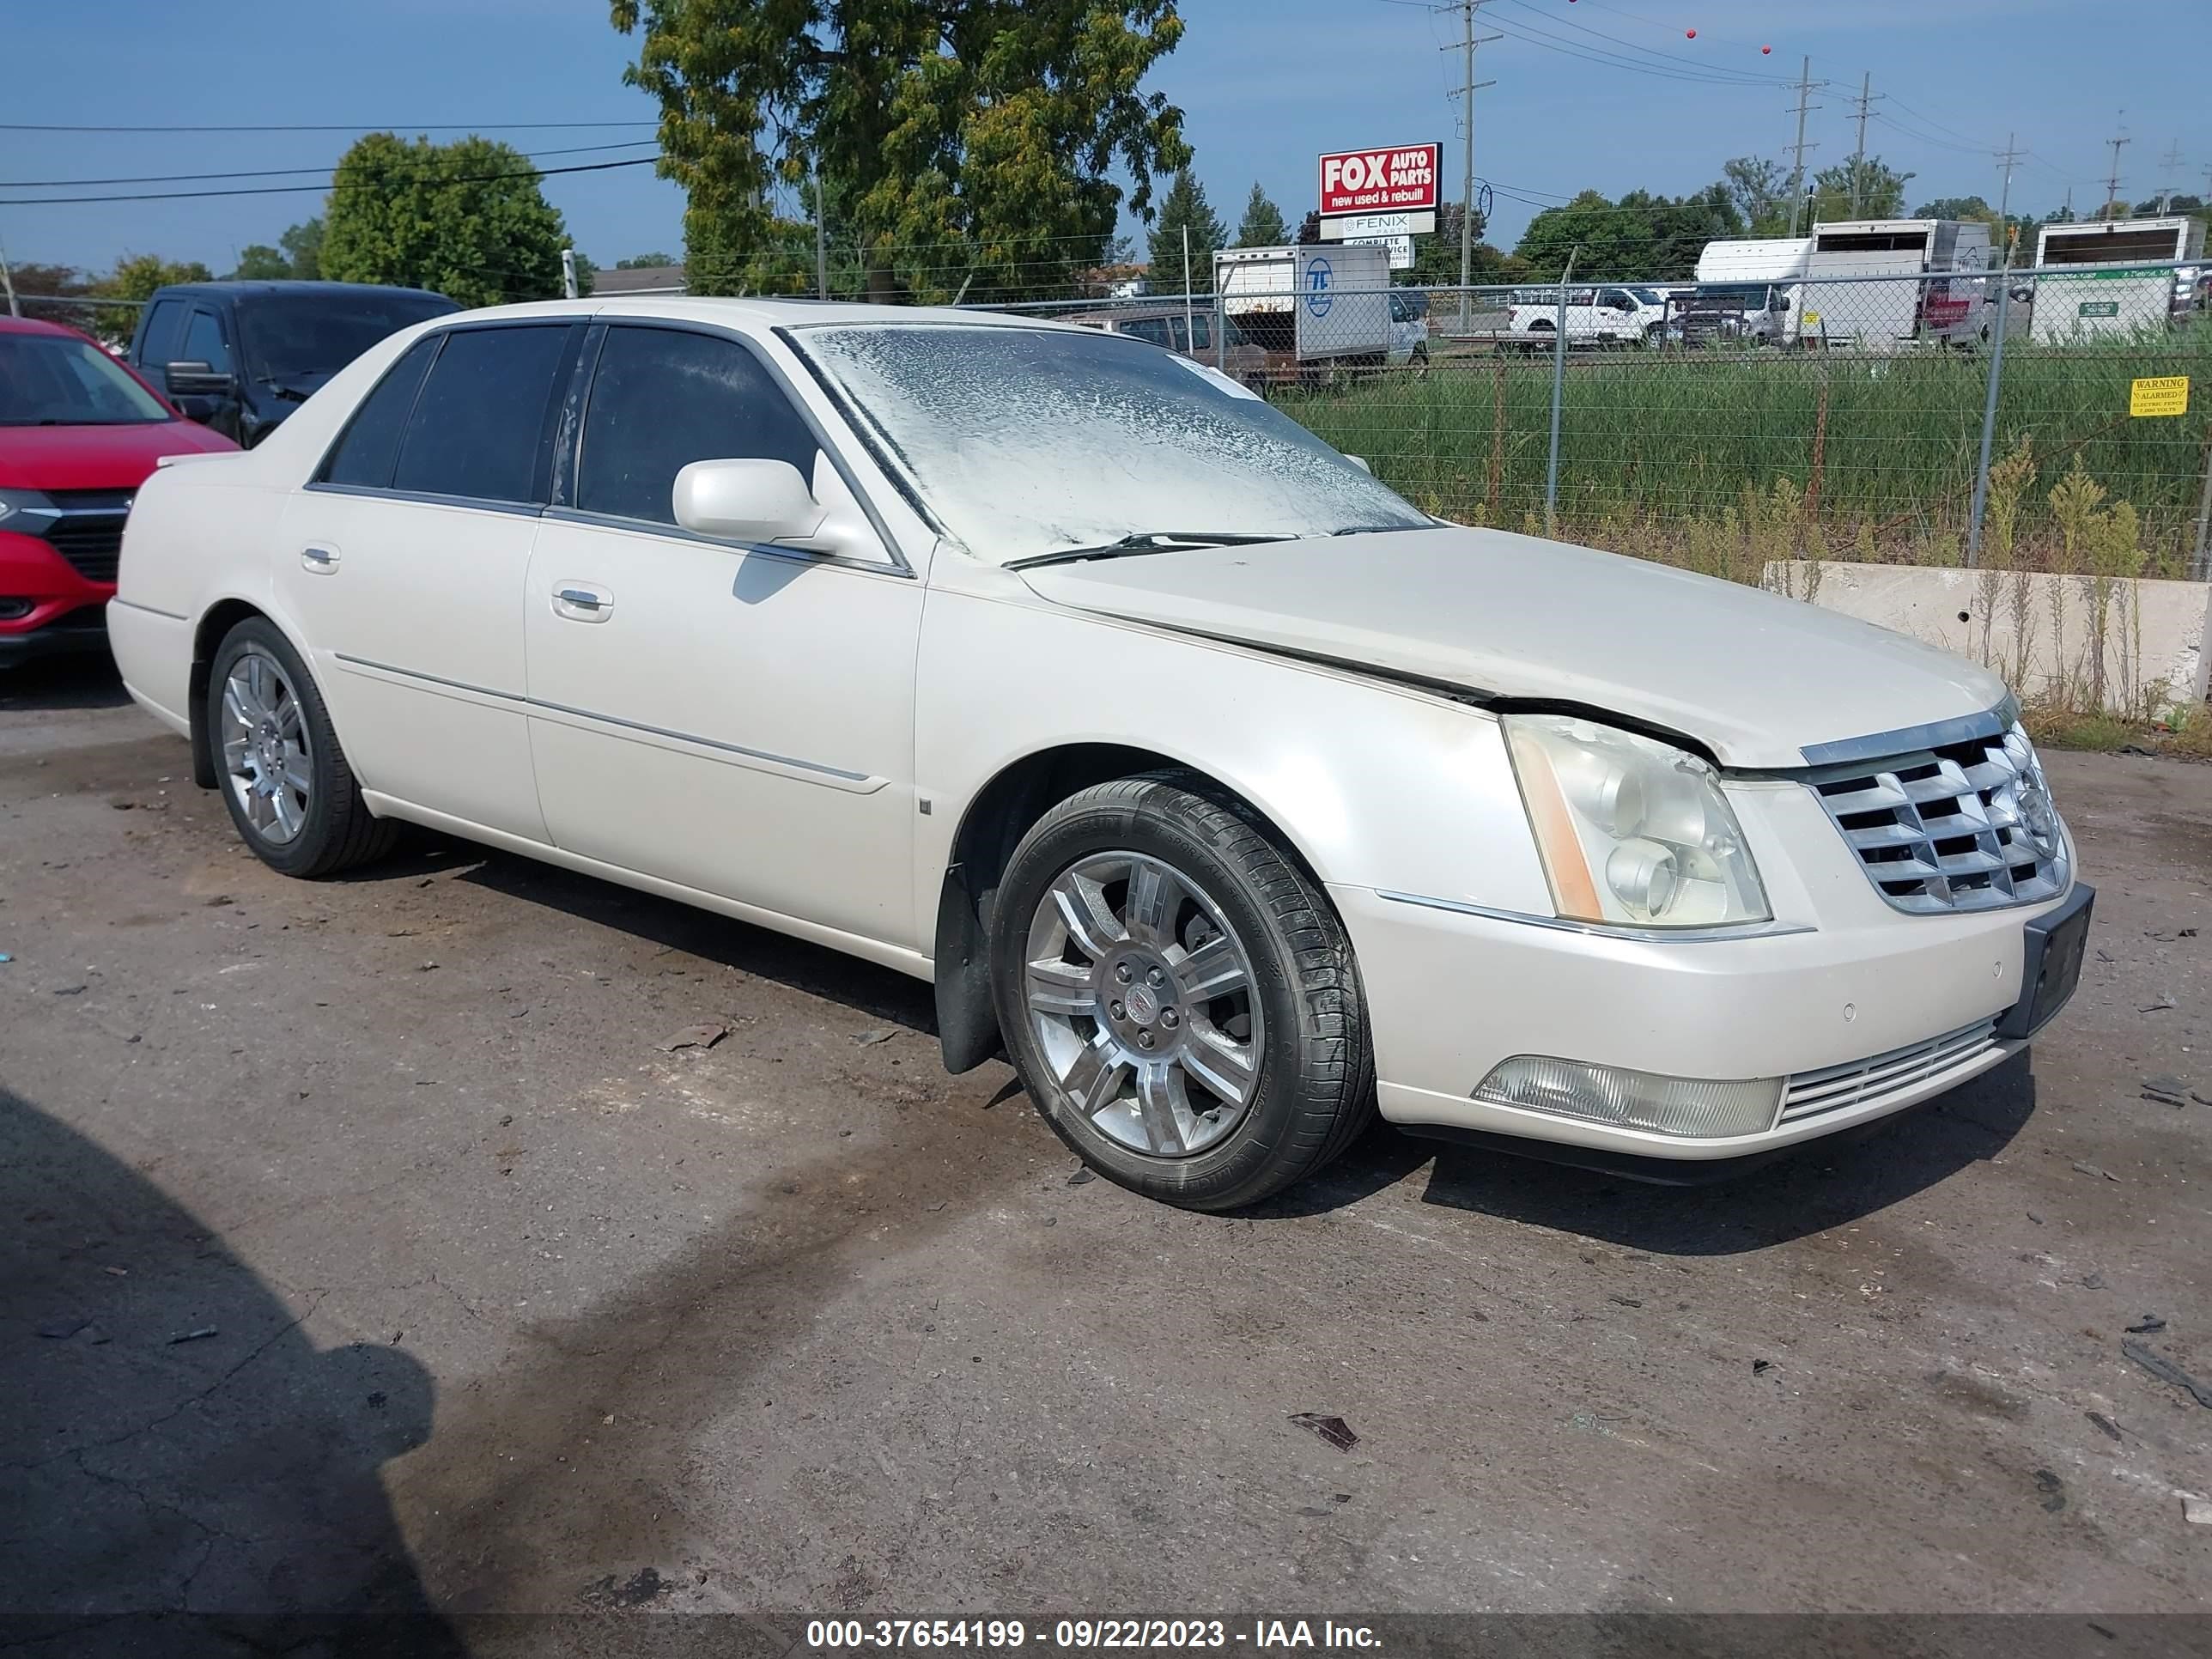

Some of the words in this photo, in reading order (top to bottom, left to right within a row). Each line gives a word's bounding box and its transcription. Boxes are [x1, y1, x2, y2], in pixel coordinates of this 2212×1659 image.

[1391, 151, 1428, 170] AUTO
[1325, 155, 1389, 192] FOX
[1391, 167, 1432, 187] PARTS
[1332, 196, 1352, 207] new
[1355, 191, 1379, 205] used
[1381, 190, 1389, 203] &
[1392, 187, 1424, 203] rebuilt
[1357, 215, 1408, 229] FENIX
[2136, 379, 2185, 389] WARNING
